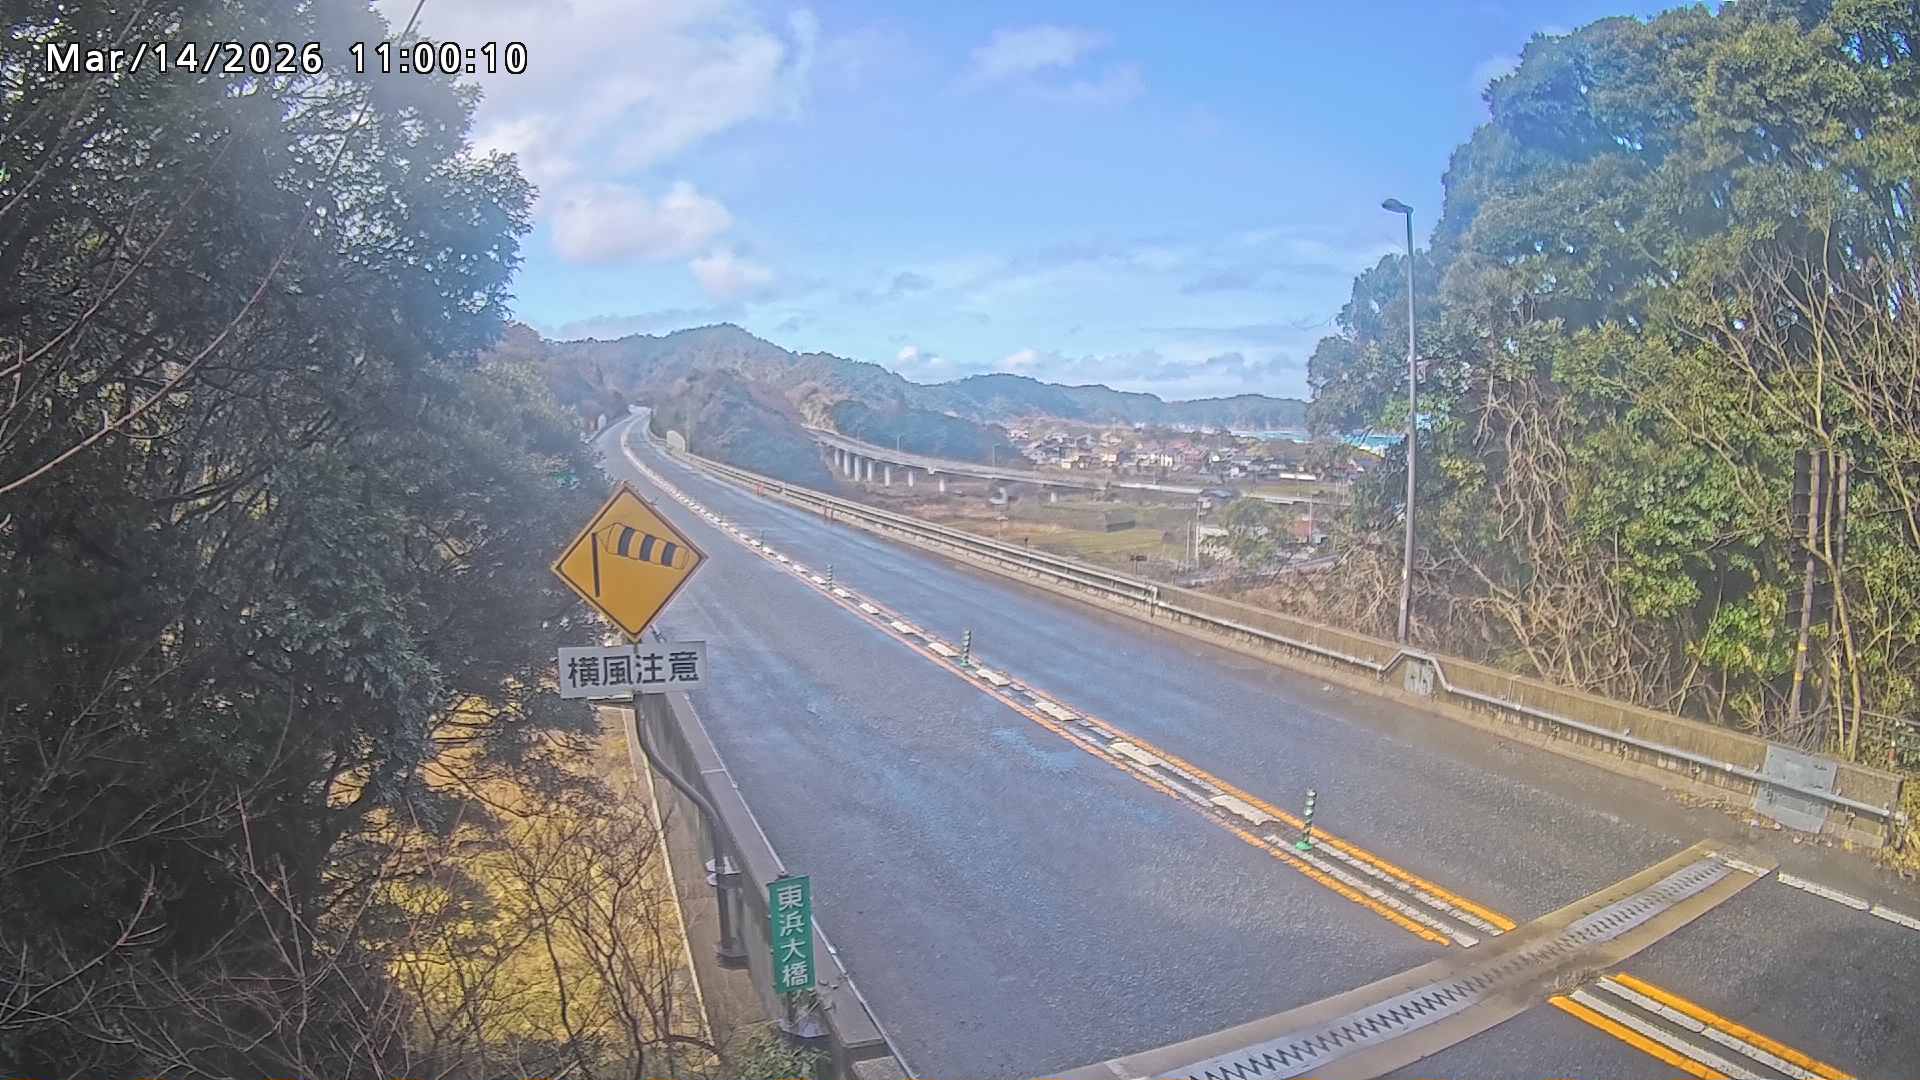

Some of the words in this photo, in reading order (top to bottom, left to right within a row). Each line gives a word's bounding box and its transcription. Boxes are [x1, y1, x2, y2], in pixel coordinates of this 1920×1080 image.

[568, 651, 699, 688] 横風注意
[776, 884, 808, 988] 東浜大橋
